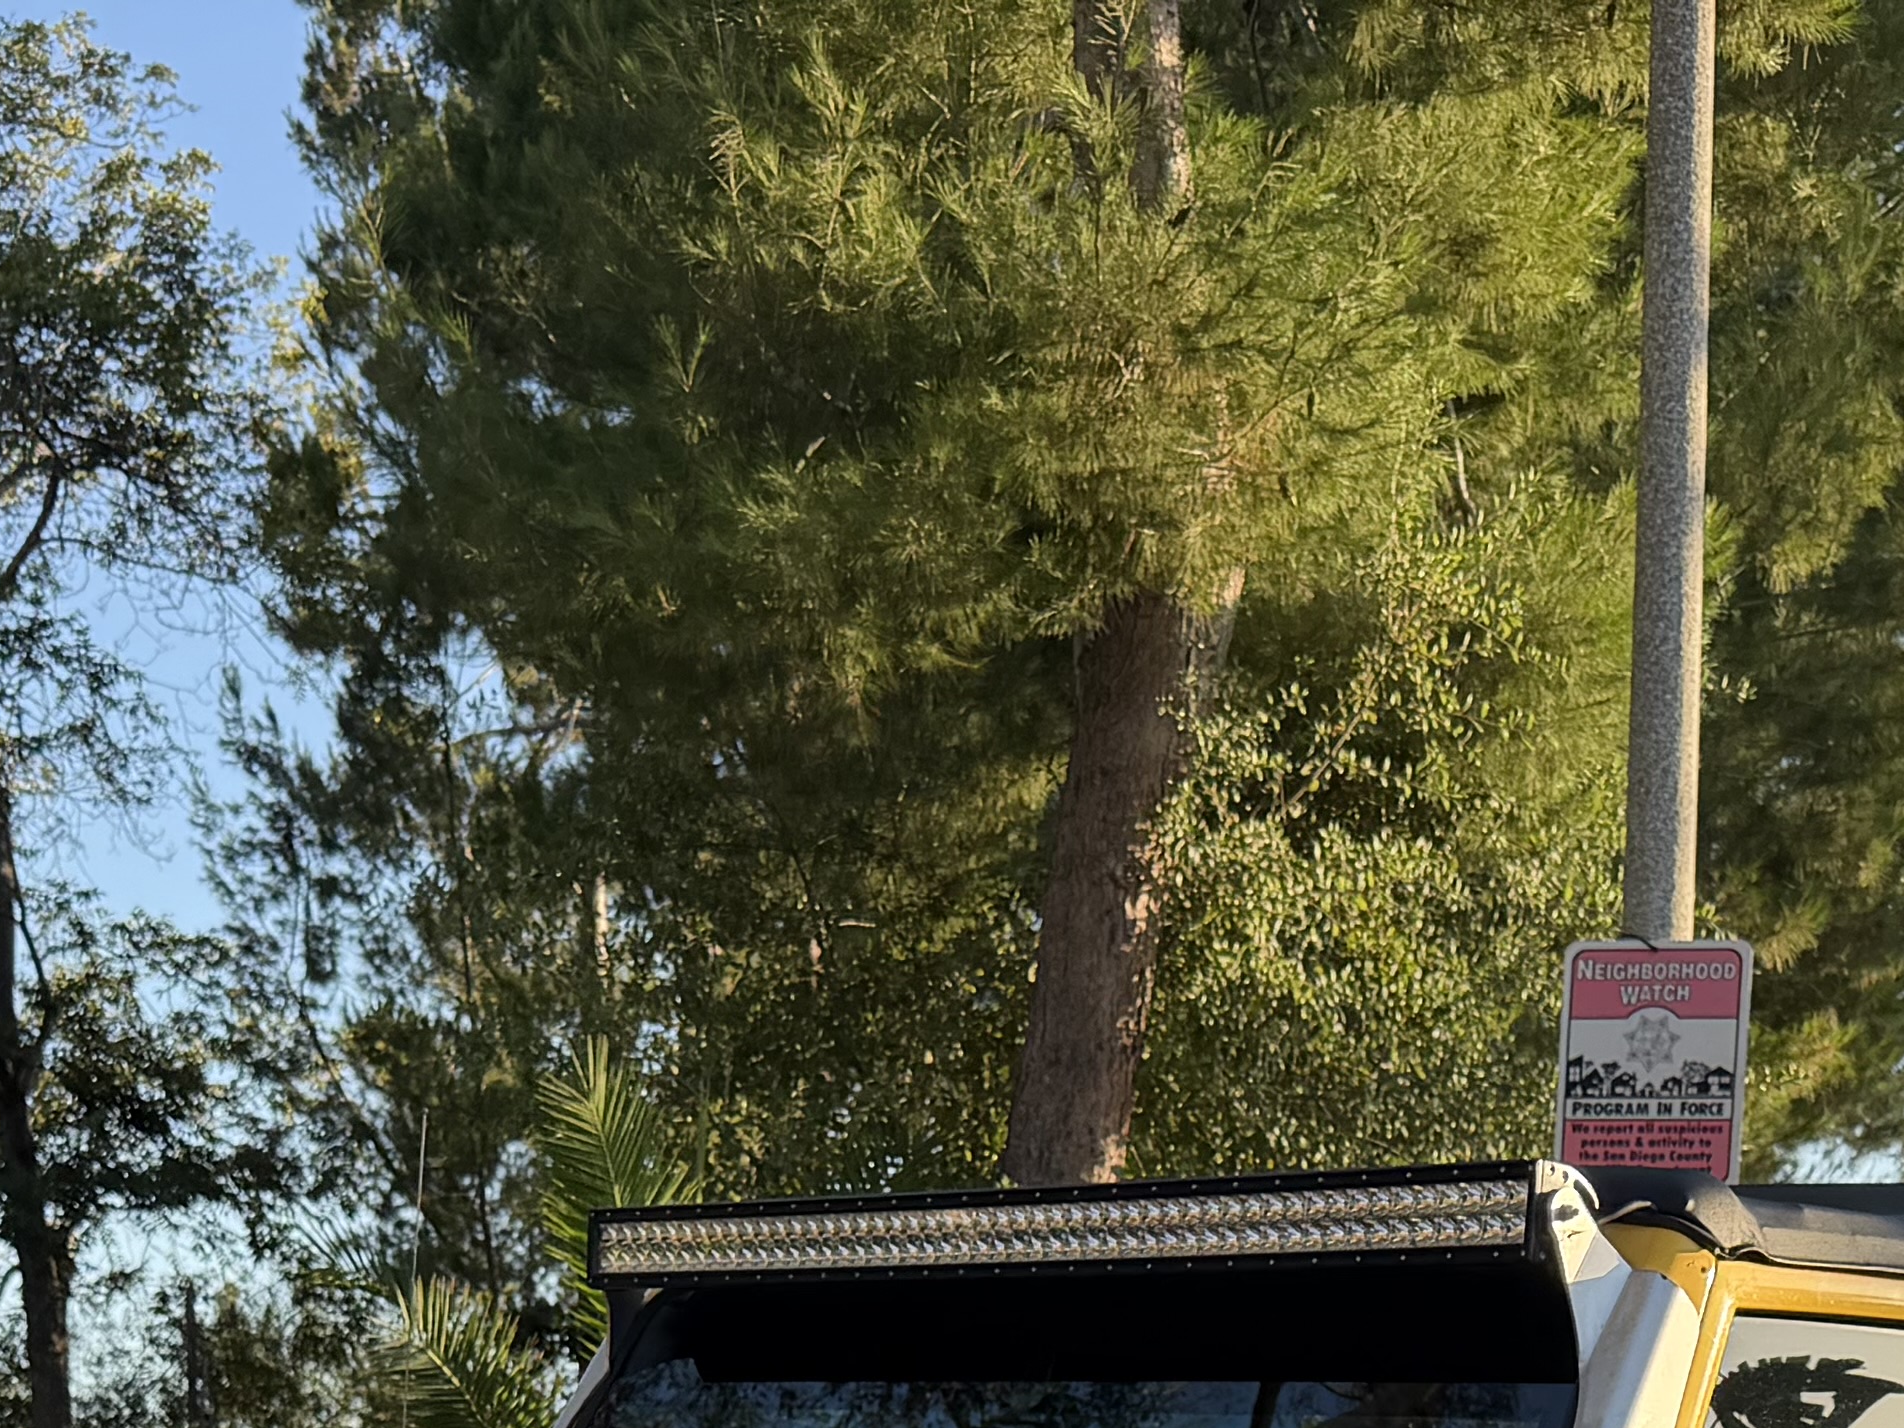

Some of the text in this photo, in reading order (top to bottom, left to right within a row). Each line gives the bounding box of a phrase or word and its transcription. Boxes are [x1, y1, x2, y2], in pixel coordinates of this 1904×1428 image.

[1577, 960, 1737, 981] NEIGHBORHOOD
[1620, 985, 1691, 1005] WATCH
[1572, 1102, 1724, 1116] PROGRAM IN FORCE
[1571, 1123, 1724, 1136] We report all suspicious
[1581, 1136, 1712, 1149] persons & activity to
[1579, 1151, 1713, 1163] the San Diego County
